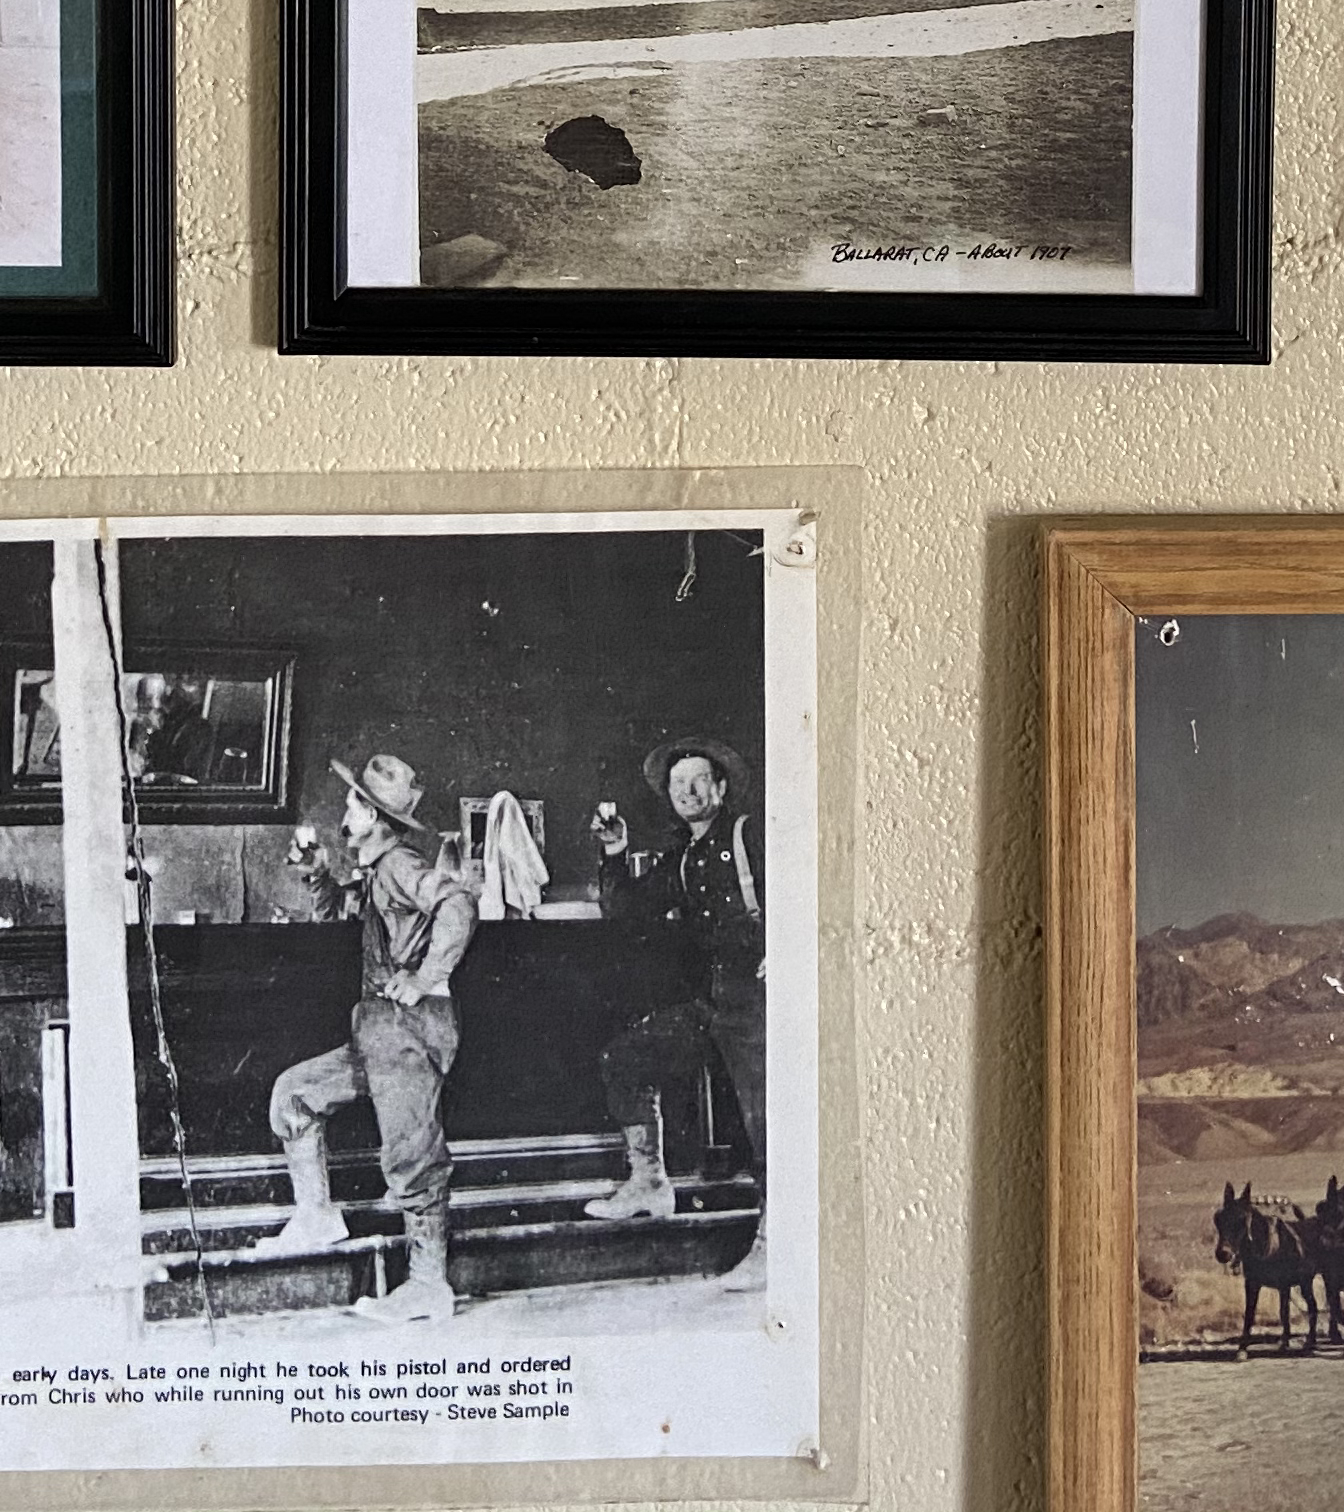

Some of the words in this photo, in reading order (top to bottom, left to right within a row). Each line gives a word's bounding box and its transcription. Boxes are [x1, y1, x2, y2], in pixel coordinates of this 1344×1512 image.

[12, 1365, 57, 1385] early
[67, 1365, 114, 1384] days.
[126, 1363, 166, 1380] Late
[176, 1366, 209, 1379] one
[219, 1361, 266, 1382] night
[276, 1361, 297, 1377] he
[307, 1361, 349, 1378] took
[360, 1359, 386, 1377] his
[396, 1357, 446, 1379] pistol
[456, 1357, 490, 1374] and
[500, 1354, 571, 1373] ordered
[48, 1386, 96, 1405] Chris
[104, 1386, 144, 1403] who
[154, 1384, 203, 1402] while
[213, 1384, 284, 1405] running
[293, 1385, 325, 1401] out
[335, 1383, 361, 1400] his
[368, 1386, 407, 1399] own
[415, 1381, 458, 1398] door
[466, 1383, 501, 1397] was
[508, 1379, 548, 1396] shot
[556, 1377, 572, 1394] in
[290, 1406, 344, 1423] Photo
[350, 1407, 429, 1424] courtesy
[447, 1403, 497, 1420] Steve
[502, 1400, 569, 1420] Sample
